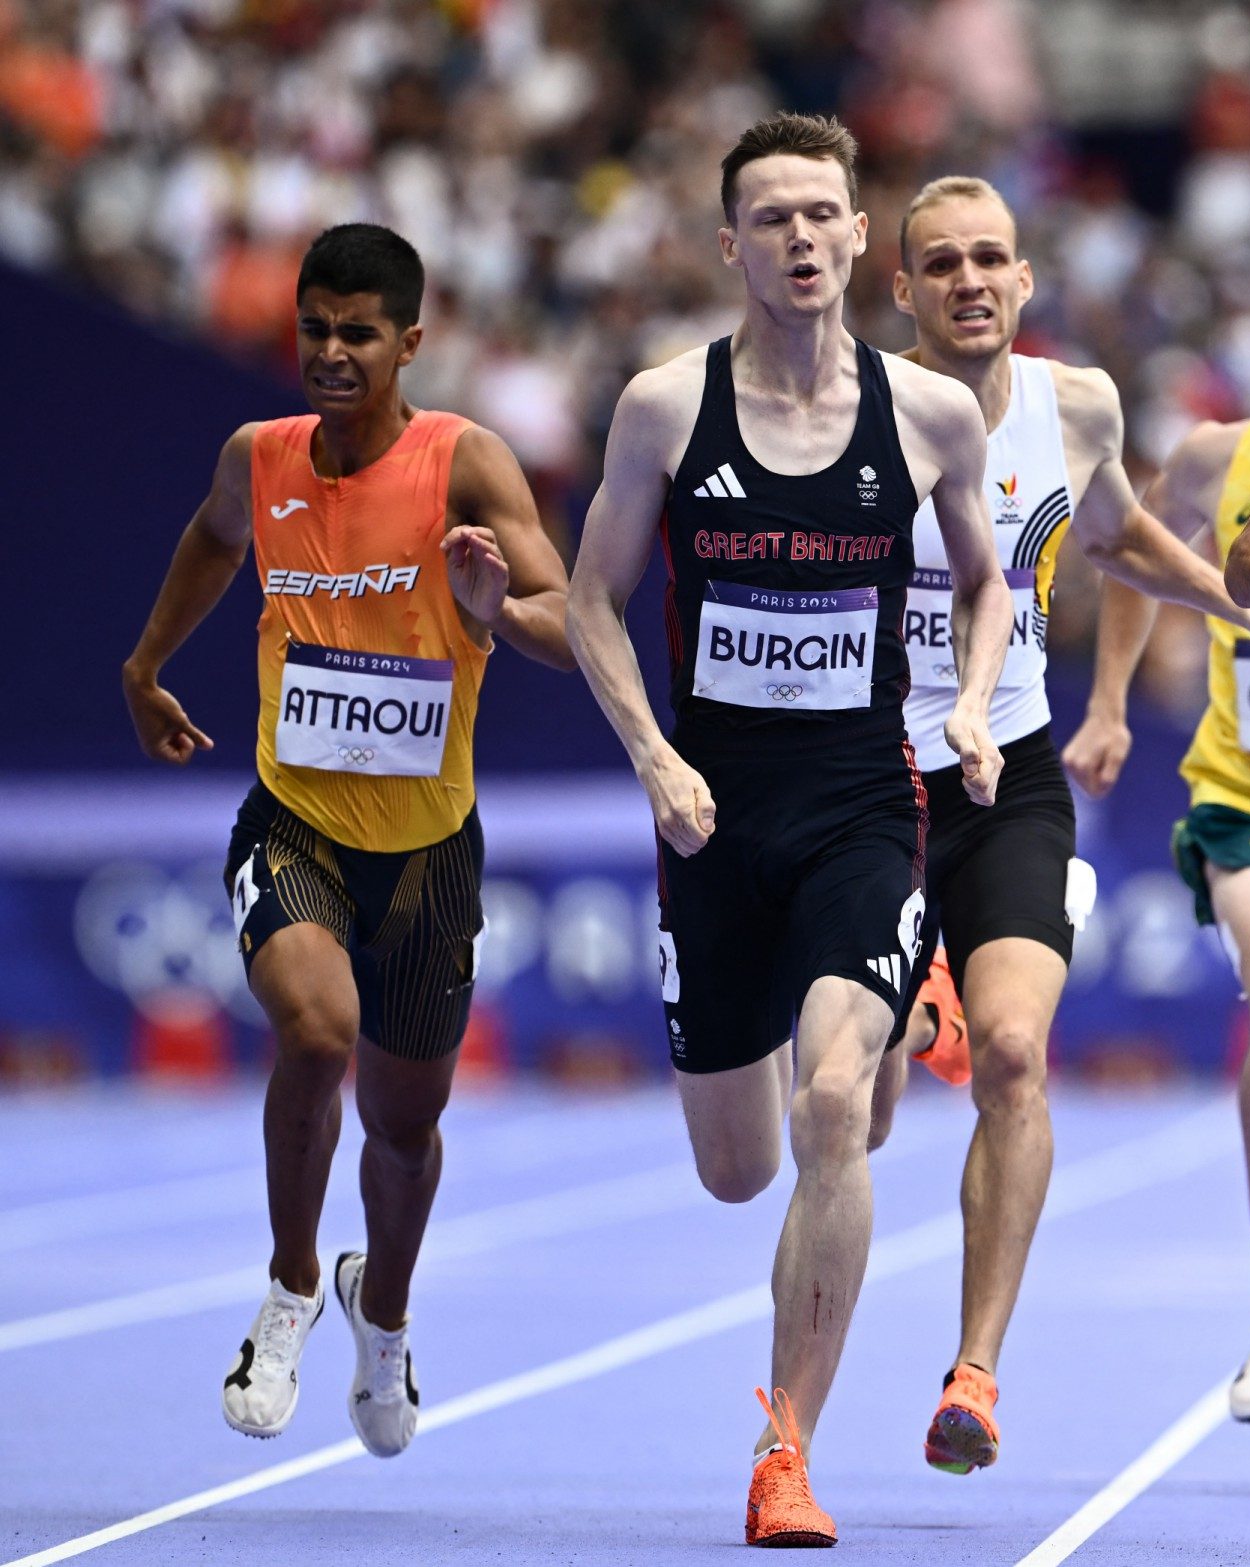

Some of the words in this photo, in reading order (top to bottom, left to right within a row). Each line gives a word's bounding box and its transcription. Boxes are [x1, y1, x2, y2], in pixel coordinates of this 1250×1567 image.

[694, 530, 785, 560] GREAT
[790, 531, 895, 561] BRITAIN
[263, 564, 421, 599] ESPAÑA
[750, 592, 795, 608] PARIS
[800, 597, 838, 608] 2024
[325, 652, 366, 668] PARIS
[371, 658, 411, 673] 2024
[709, 625, 867, 671] BURGIN
[284, 686, 445, 738] ATTAOUI
